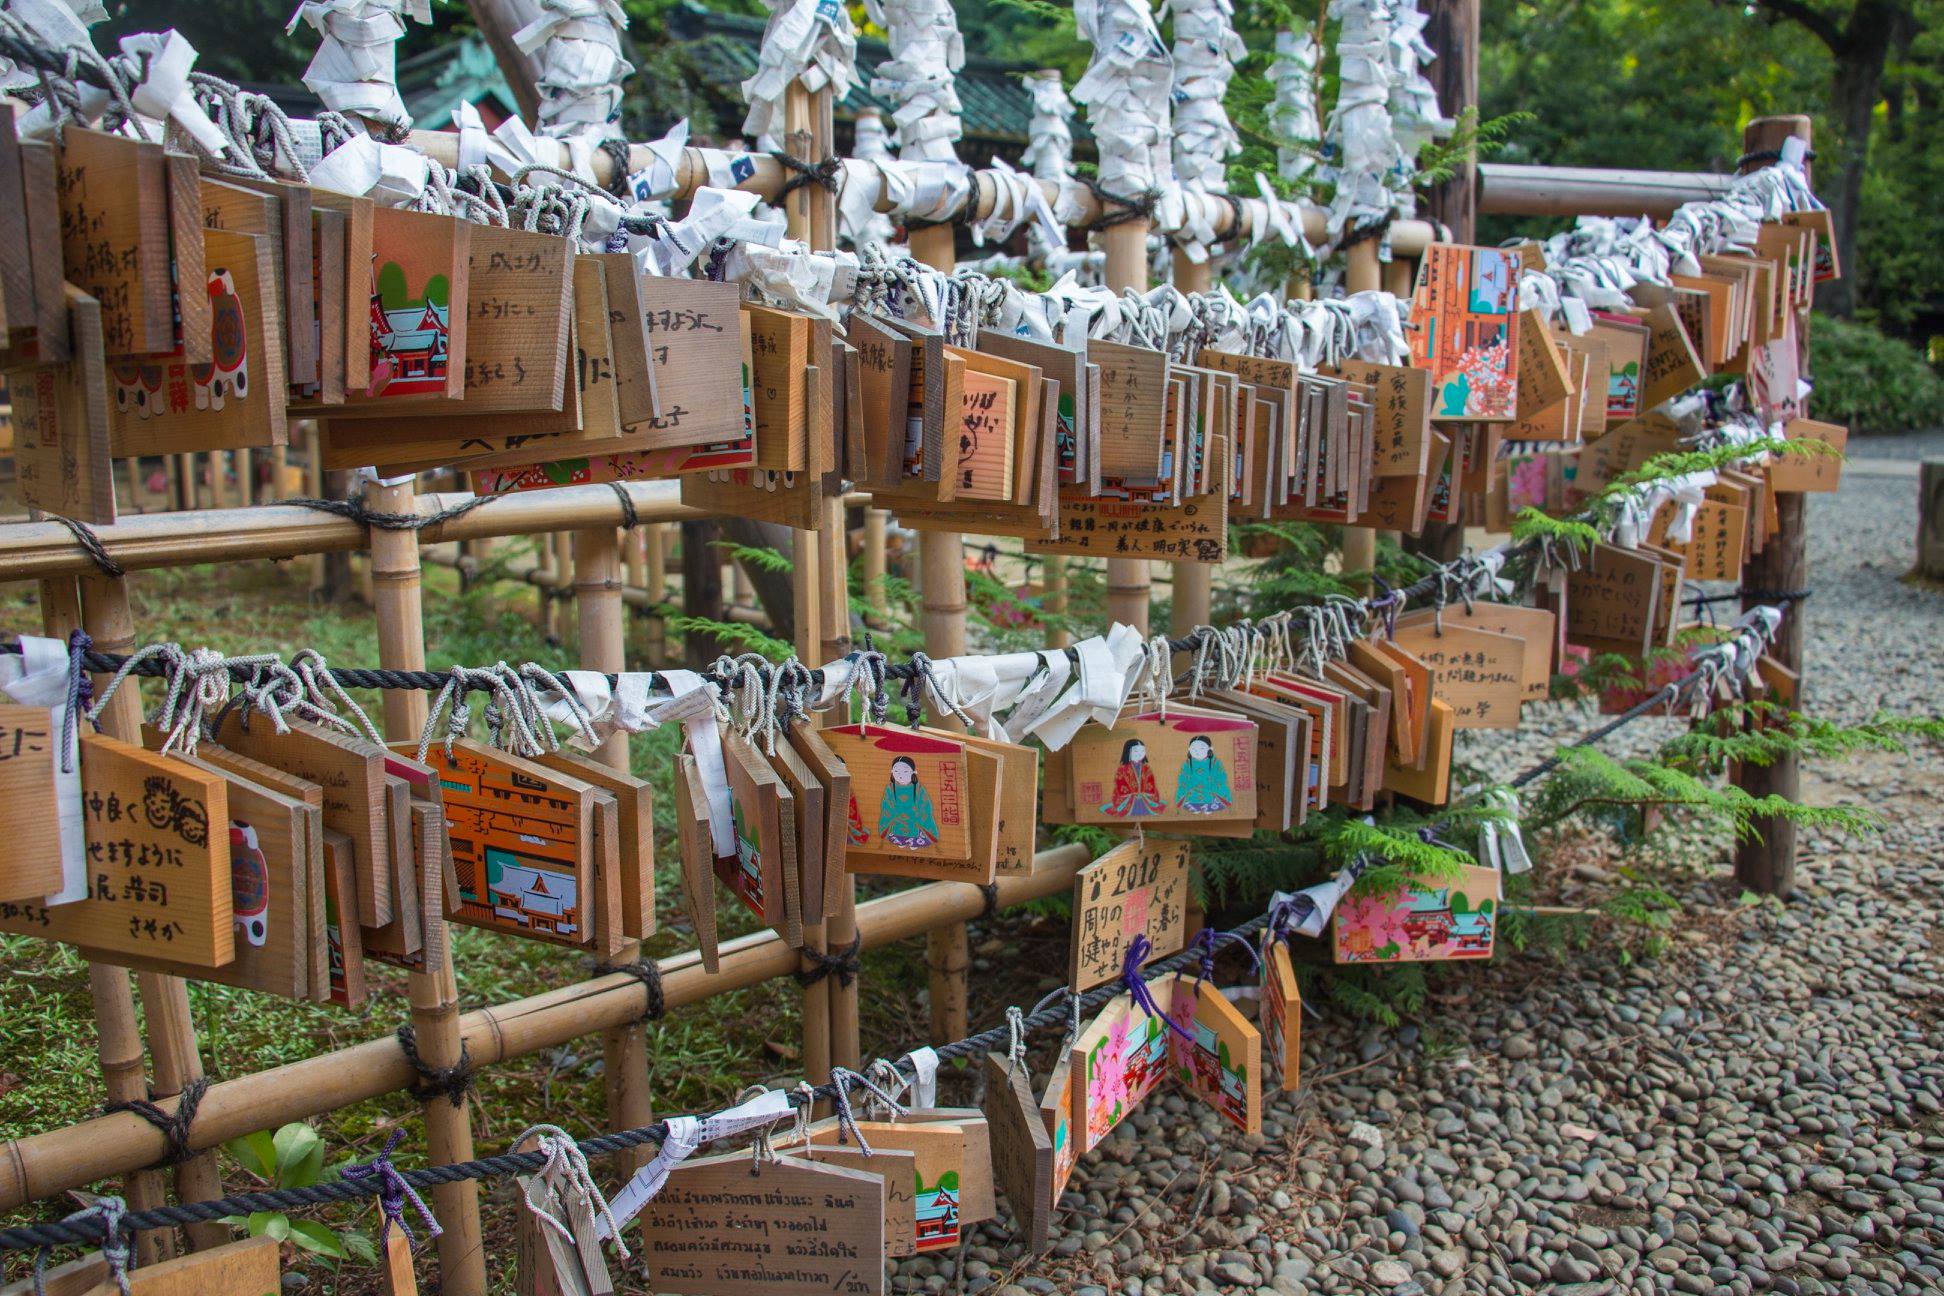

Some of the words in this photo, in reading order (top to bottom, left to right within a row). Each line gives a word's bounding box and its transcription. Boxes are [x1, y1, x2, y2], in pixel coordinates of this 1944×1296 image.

[1389, 371, 1410, 463] 家族全員が
[1111, 852, 1162, 897] 2018
